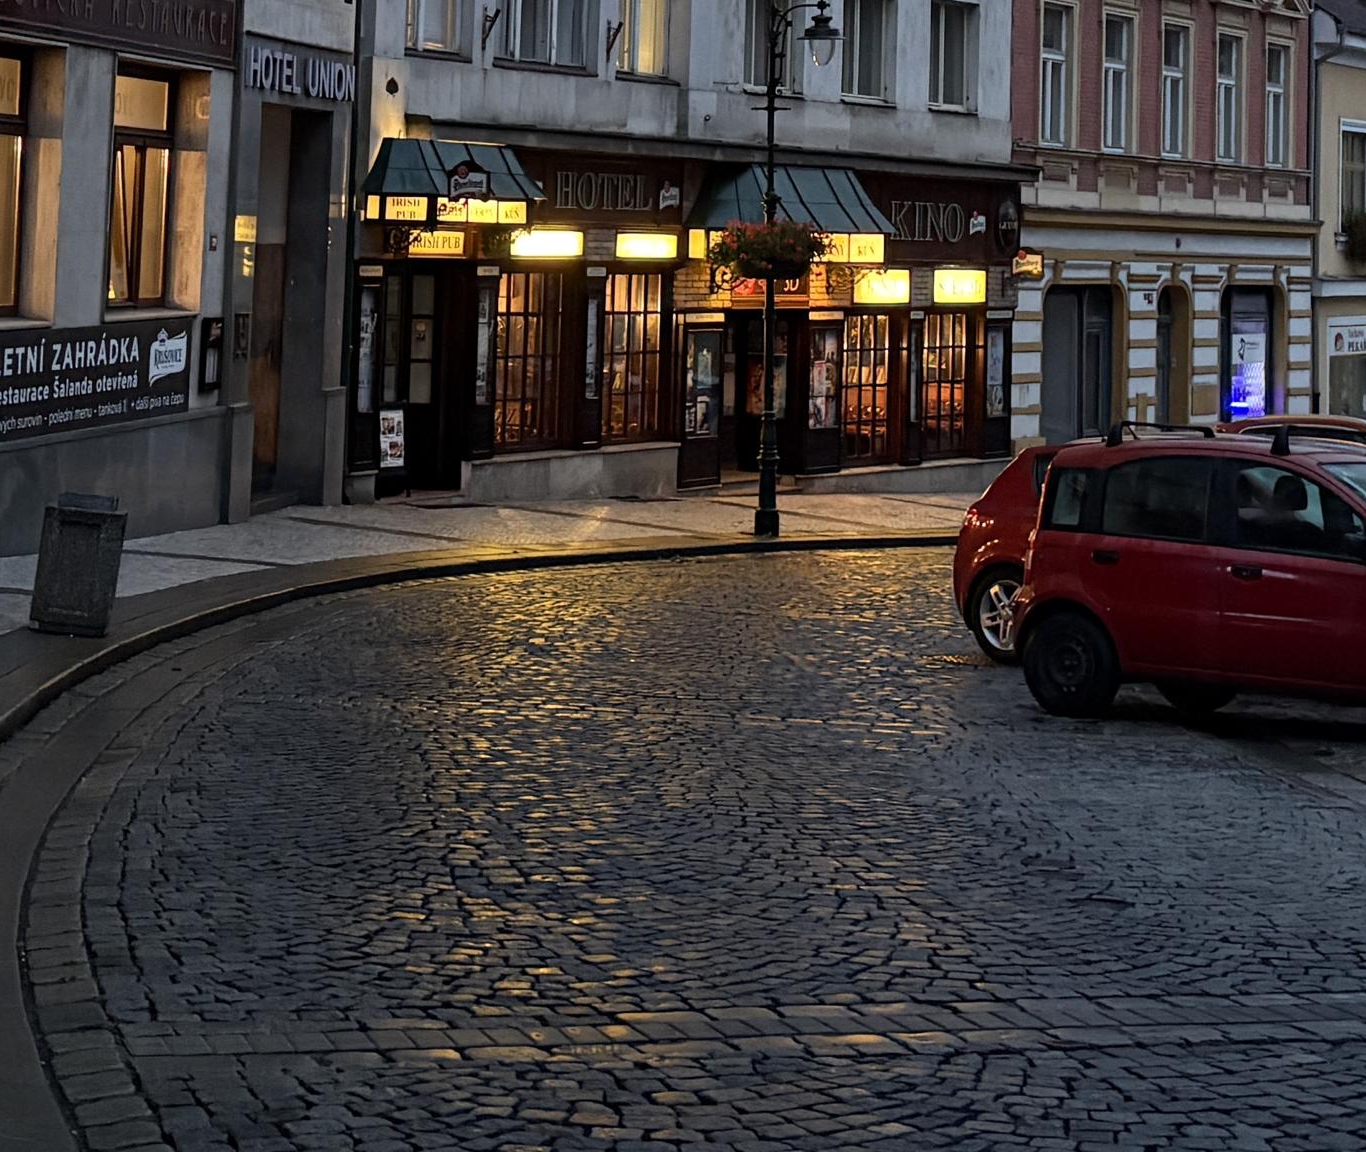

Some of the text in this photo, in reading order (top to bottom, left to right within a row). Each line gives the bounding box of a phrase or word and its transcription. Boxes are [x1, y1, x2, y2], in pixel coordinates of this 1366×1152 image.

[247, 45, 355, 102] HOTEL UNION
[391, 197, 420, 207] IRISH
[555, 171, 653, 210] HOTEL
[396, 211, 417, 219] PUB
[889, 200, 965, 243] KINO
[442, 235, 461, 249] PUB
[51, 332, 140, 371] ZAHRÁDKA
[53, 376, 93, 398] Šalanda
[96, 369, 138, 393] otevřená
[17, 414, 43, 429] surovin
